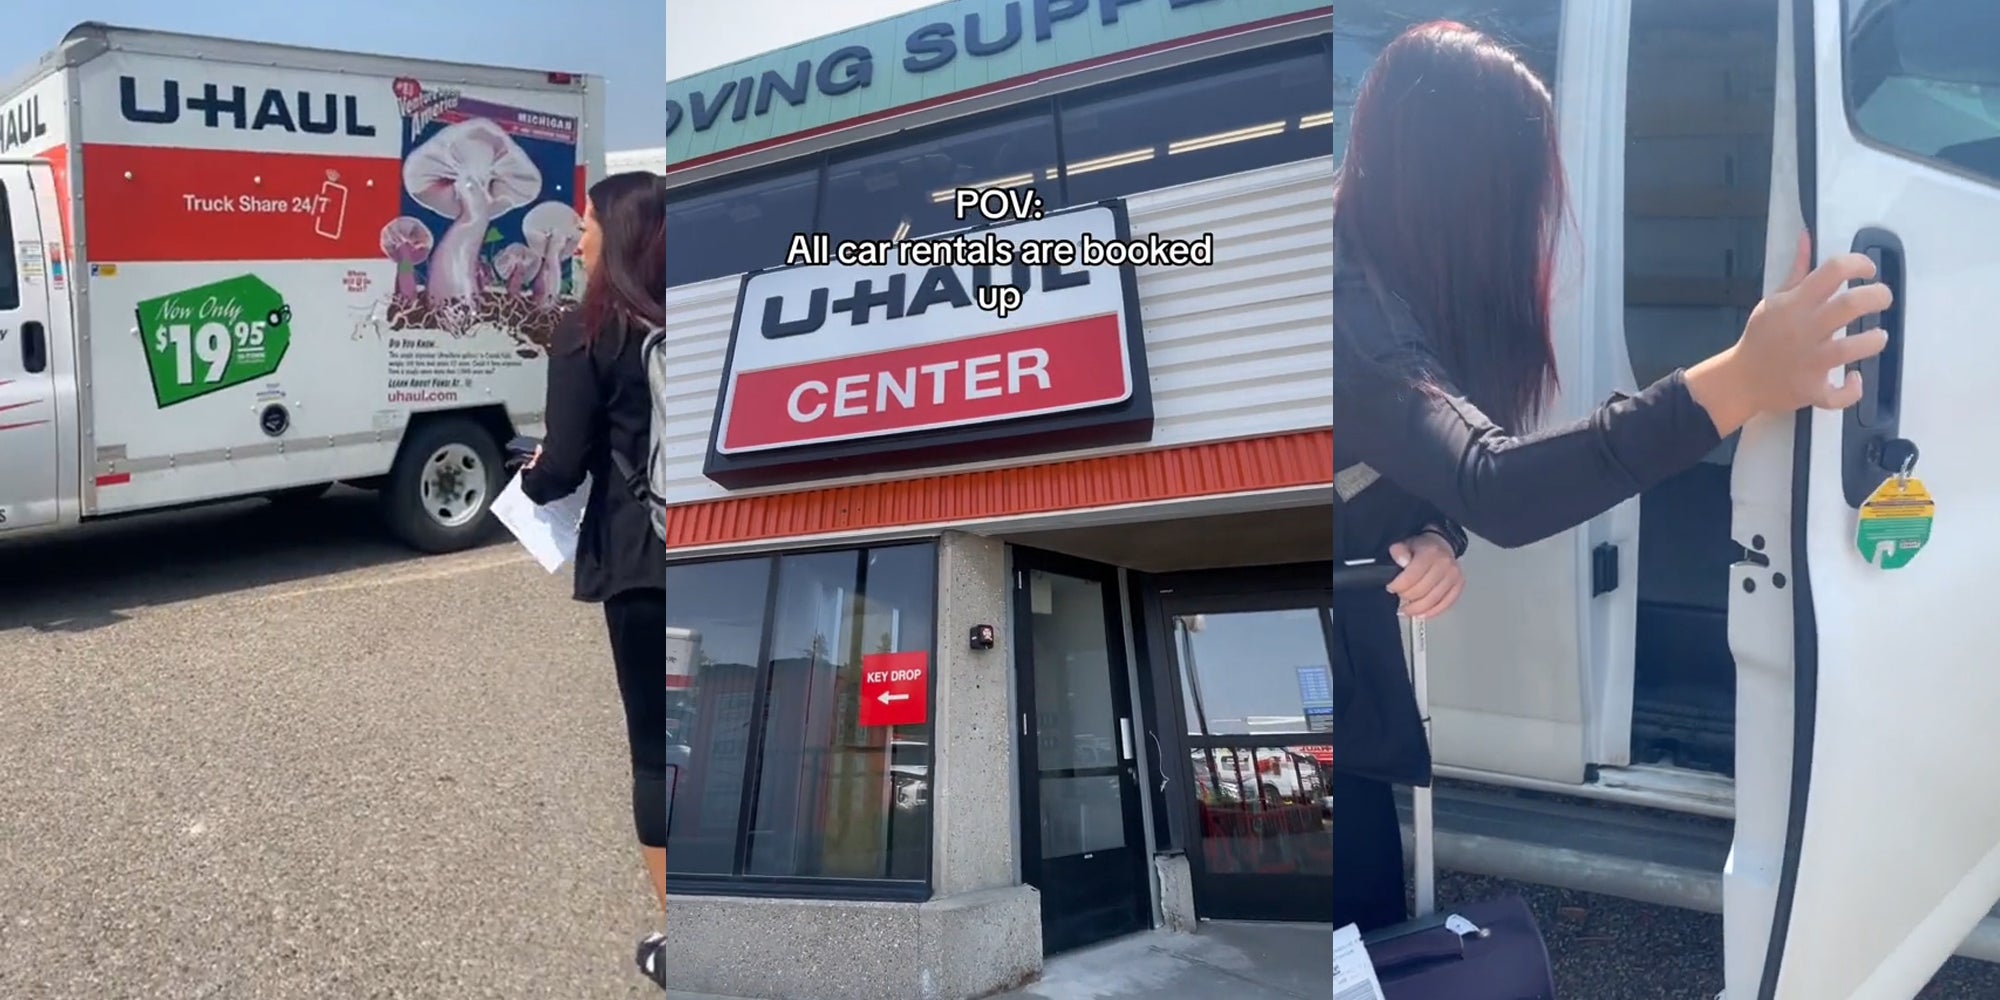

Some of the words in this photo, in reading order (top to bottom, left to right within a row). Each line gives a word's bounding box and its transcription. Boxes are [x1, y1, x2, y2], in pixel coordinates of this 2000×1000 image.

[120, 76, 375, 137] U-HAUL
[518, 113, 572, 130] MICHIGAN
[183, 194, 235, 212] Truck
[239, 195, 288, 212] Share
[292, 195, 330, 216] 24/7
[155, 299, 192, 320] Now
[199, 296, 243, 324] Only
[388, 390, 457, 402] uhaul.com
[787, 348, 1052, 424] CENTER
[867, 671, 888, 683] KEY
[891, 669, 922, 681] DROP
